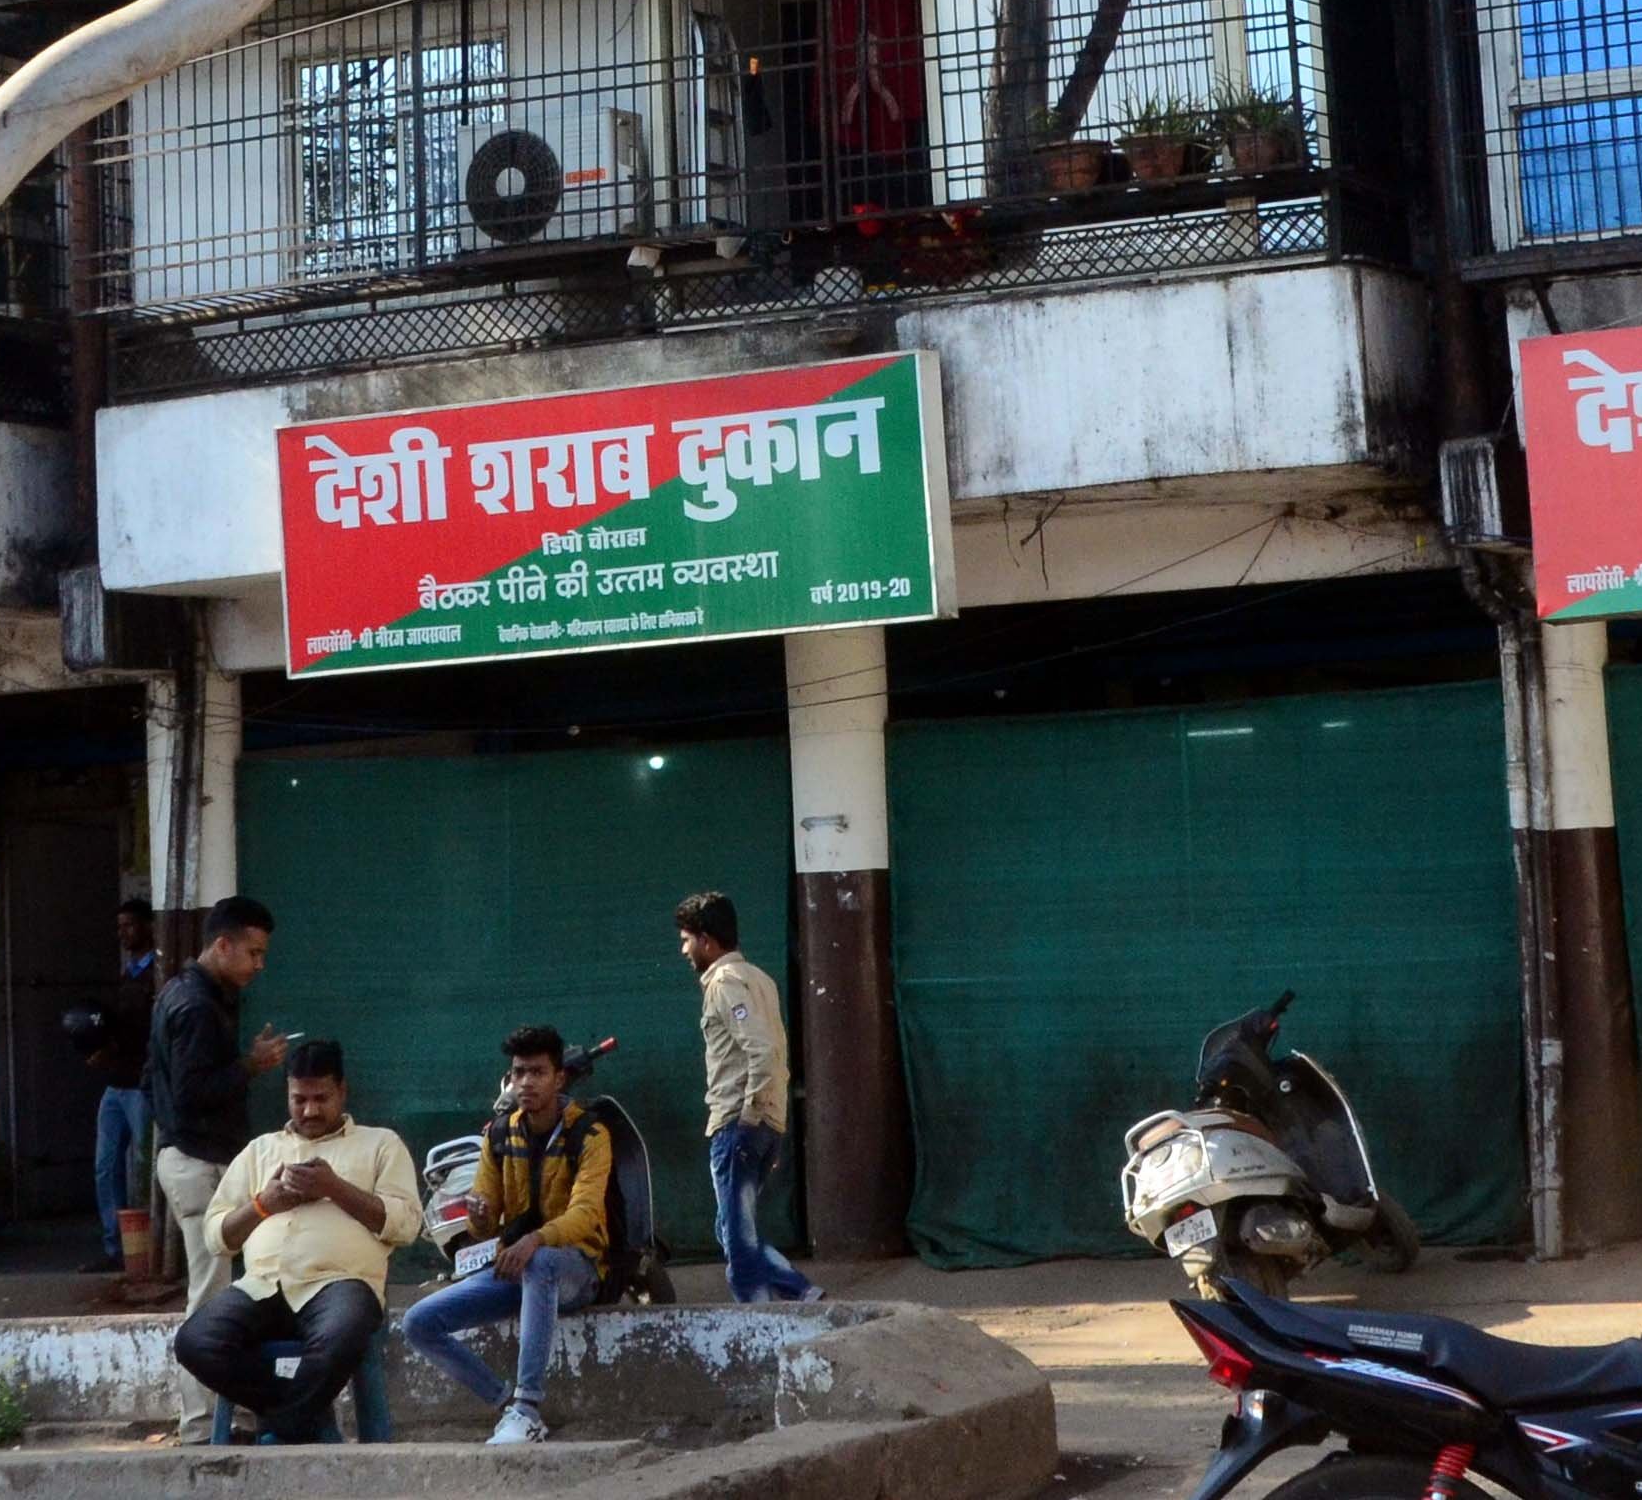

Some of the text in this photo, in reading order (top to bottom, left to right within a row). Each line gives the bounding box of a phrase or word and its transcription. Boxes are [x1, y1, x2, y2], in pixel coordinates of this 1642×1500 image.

[305, 395, 885, 529] देशी शराब दुकान
[541, 526, 647, 557] डिपो चौराहा
[418, 551, 779, 612] बैठकर पीने की उत्तम व्यवस्था
[810, 578, 911, 604] वर्ष 2019-20
[359, 628, 373, 649] श्री
[375, 626, 404, 647] नीरज
[407, 625, 461, 645] जायसवाल
